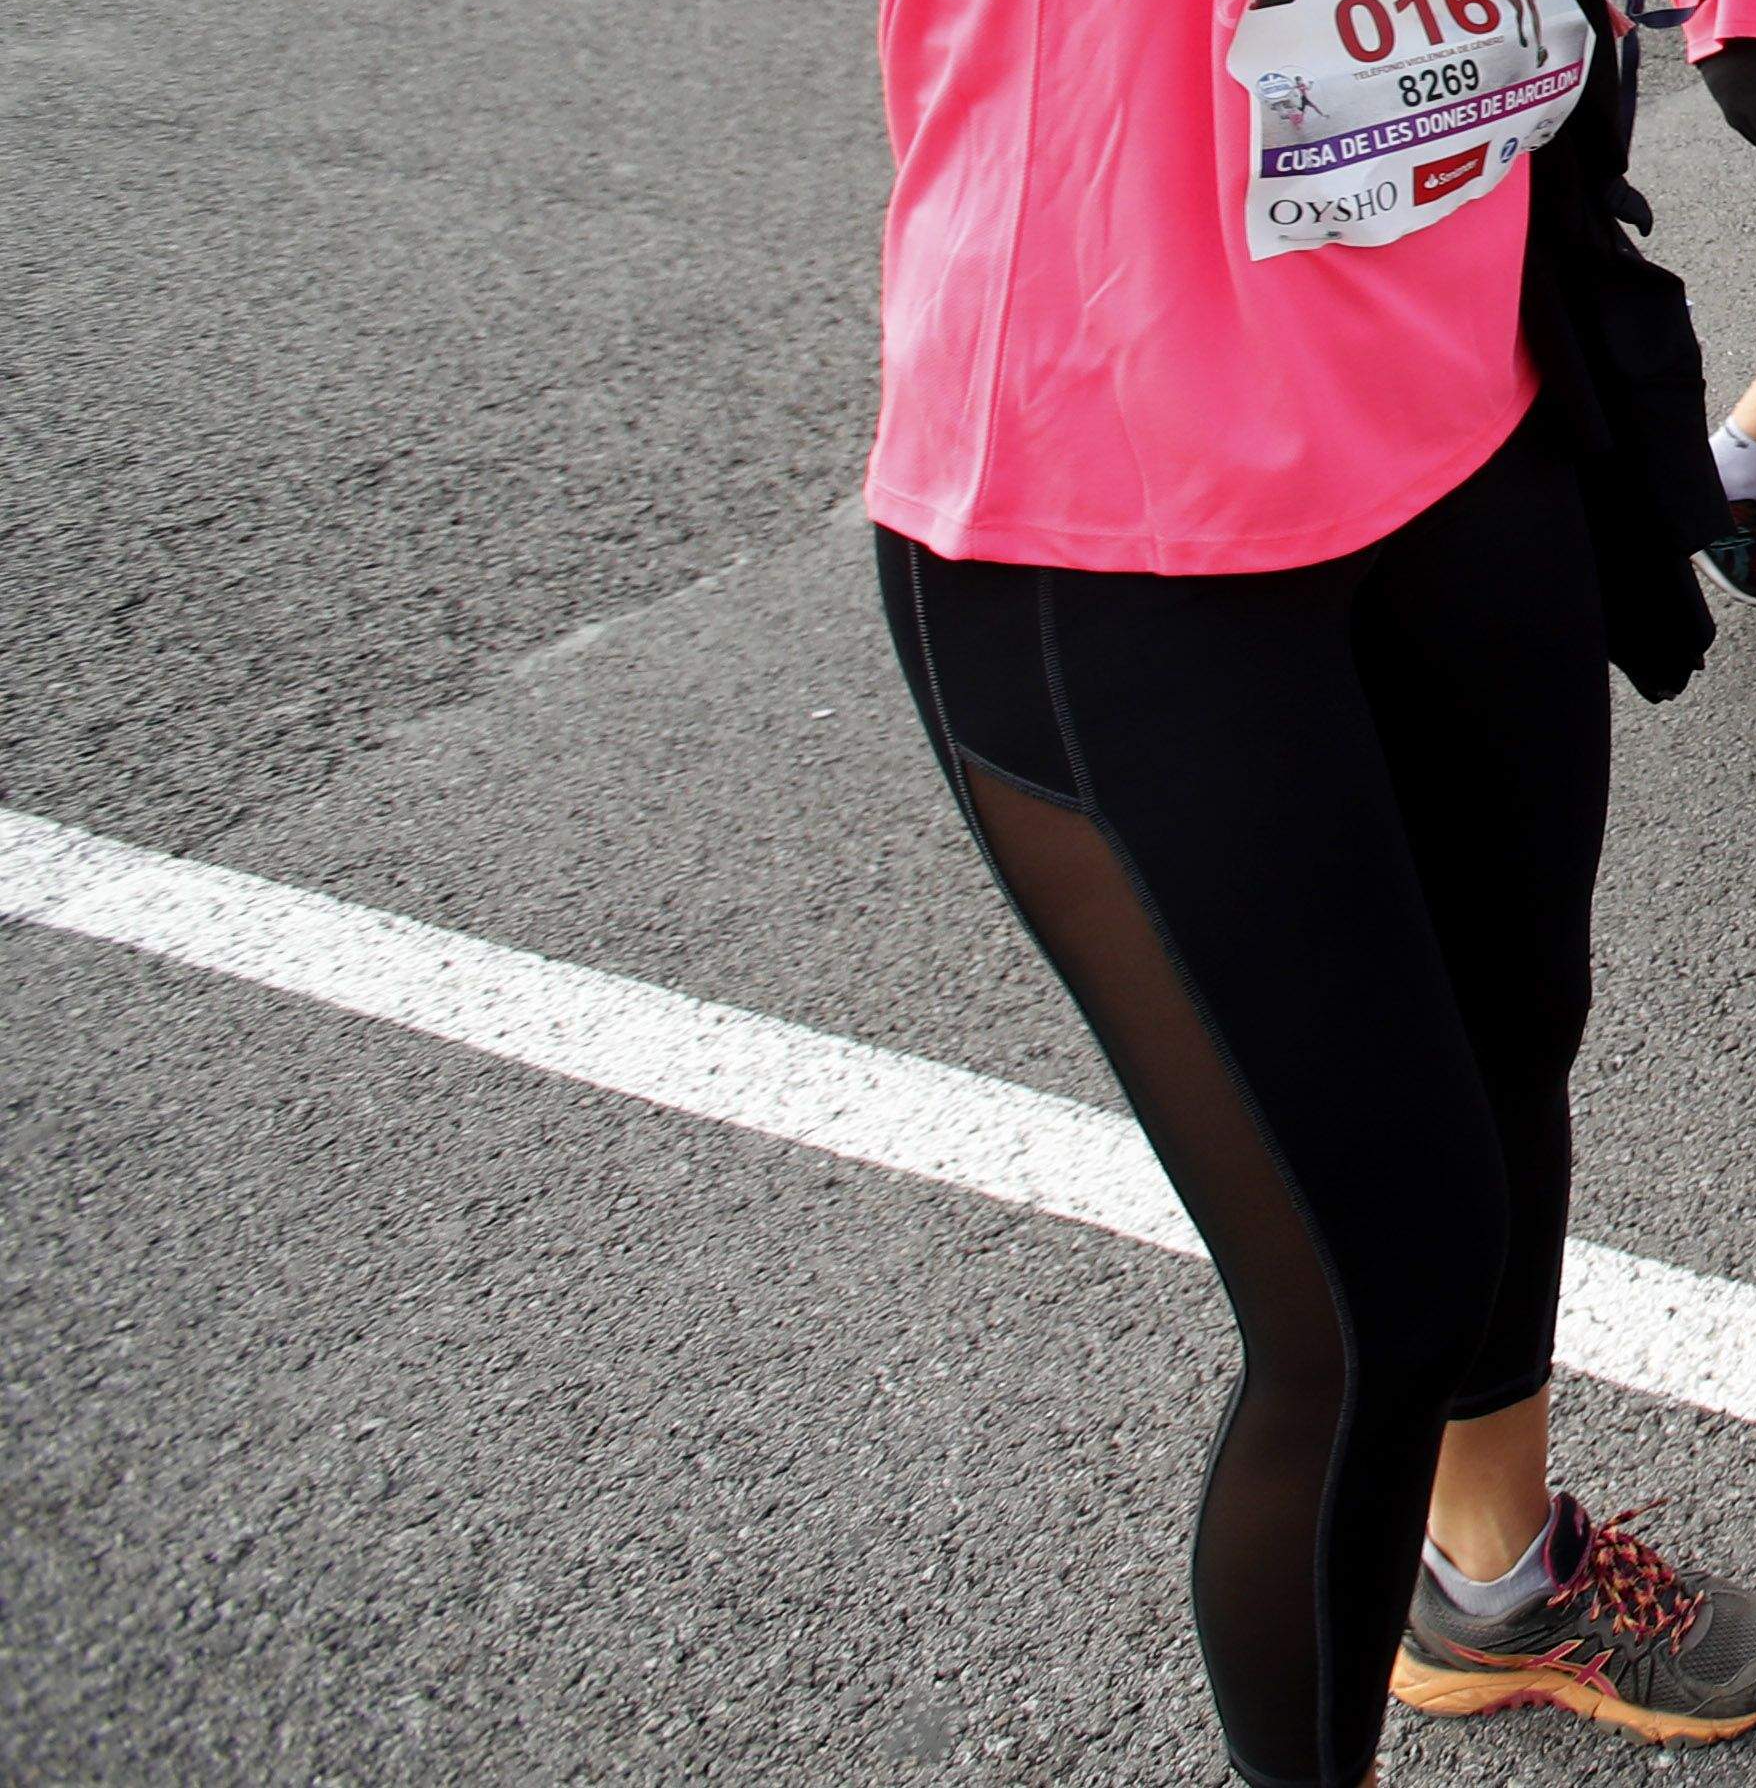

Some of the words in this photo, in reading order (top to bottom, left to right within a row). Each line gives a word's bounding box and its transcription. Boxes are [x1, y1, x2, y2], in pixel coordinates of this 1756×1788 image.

[1399, 60, 1480, 107] 8269
[1340, 134, 1370, 160] DE
[1374, 123, 1413, 150] LES
[1416, 104, 1478, 138] DONES
[1480, 97, 1500, 119] DE
[1269, 181, 1398, 225] OYSHO
